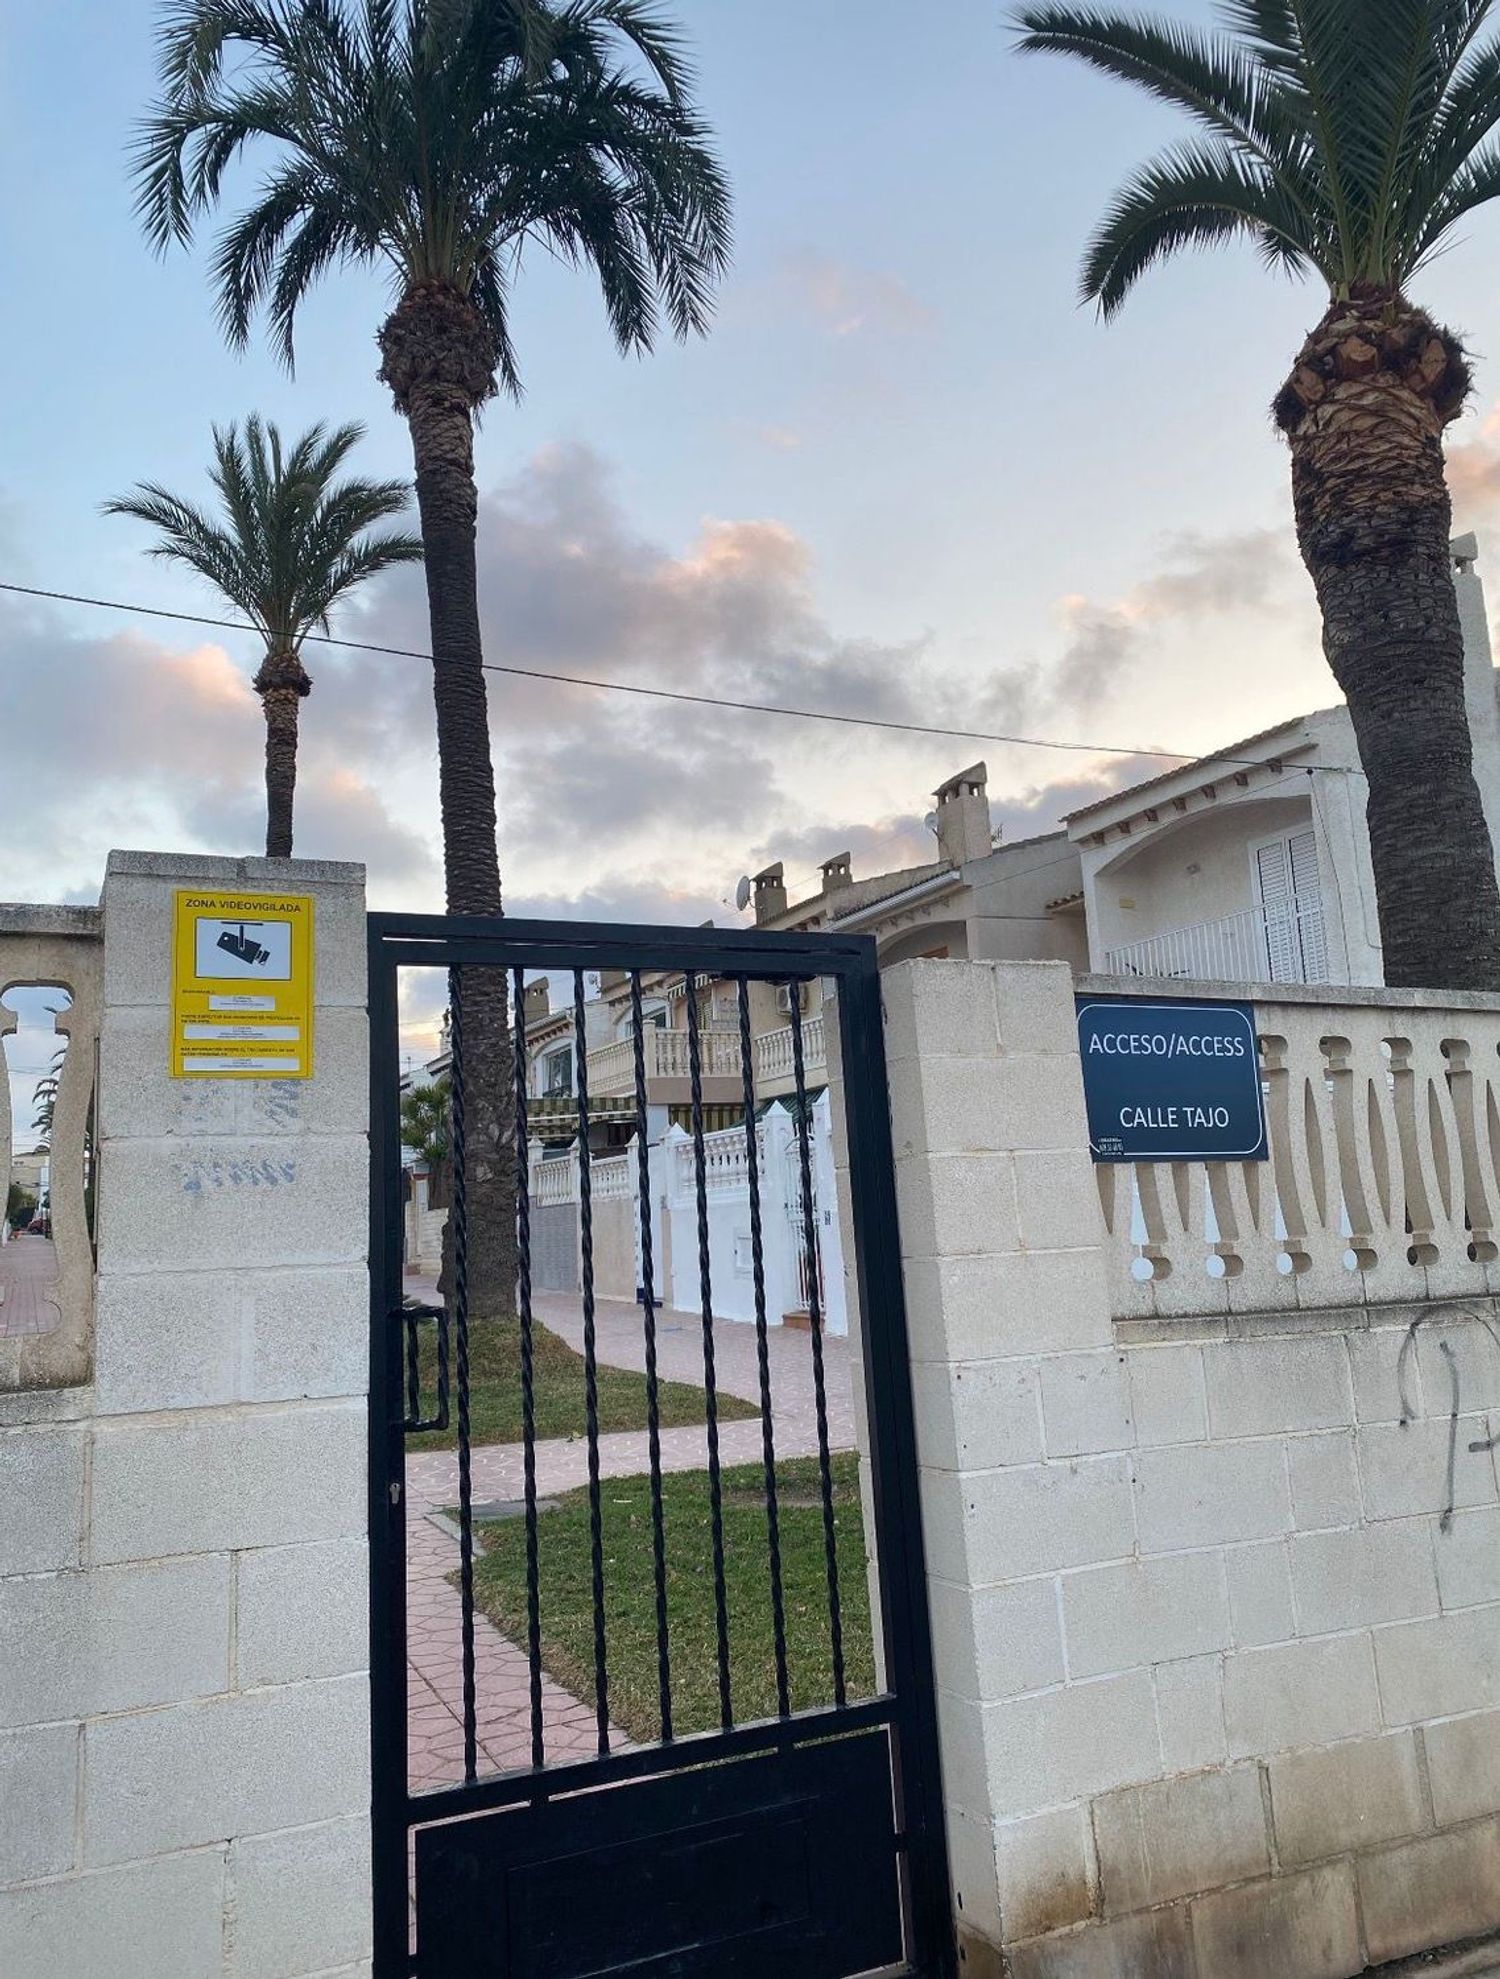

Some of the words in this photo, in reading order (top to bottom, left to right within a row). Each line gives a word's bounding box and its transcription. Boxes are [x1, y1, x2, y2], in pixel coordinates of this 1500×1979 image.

[185, 898, 216, 908] ZONA
[220, 900, 301, 912] VIDEOVIGILADA
[1089, 1033, 1245, 1058] ACCESO/ACCESS
[1119, 1106, 1179, 1128] CALLE
[1183, 1107, 1230, 1128] TAJO
